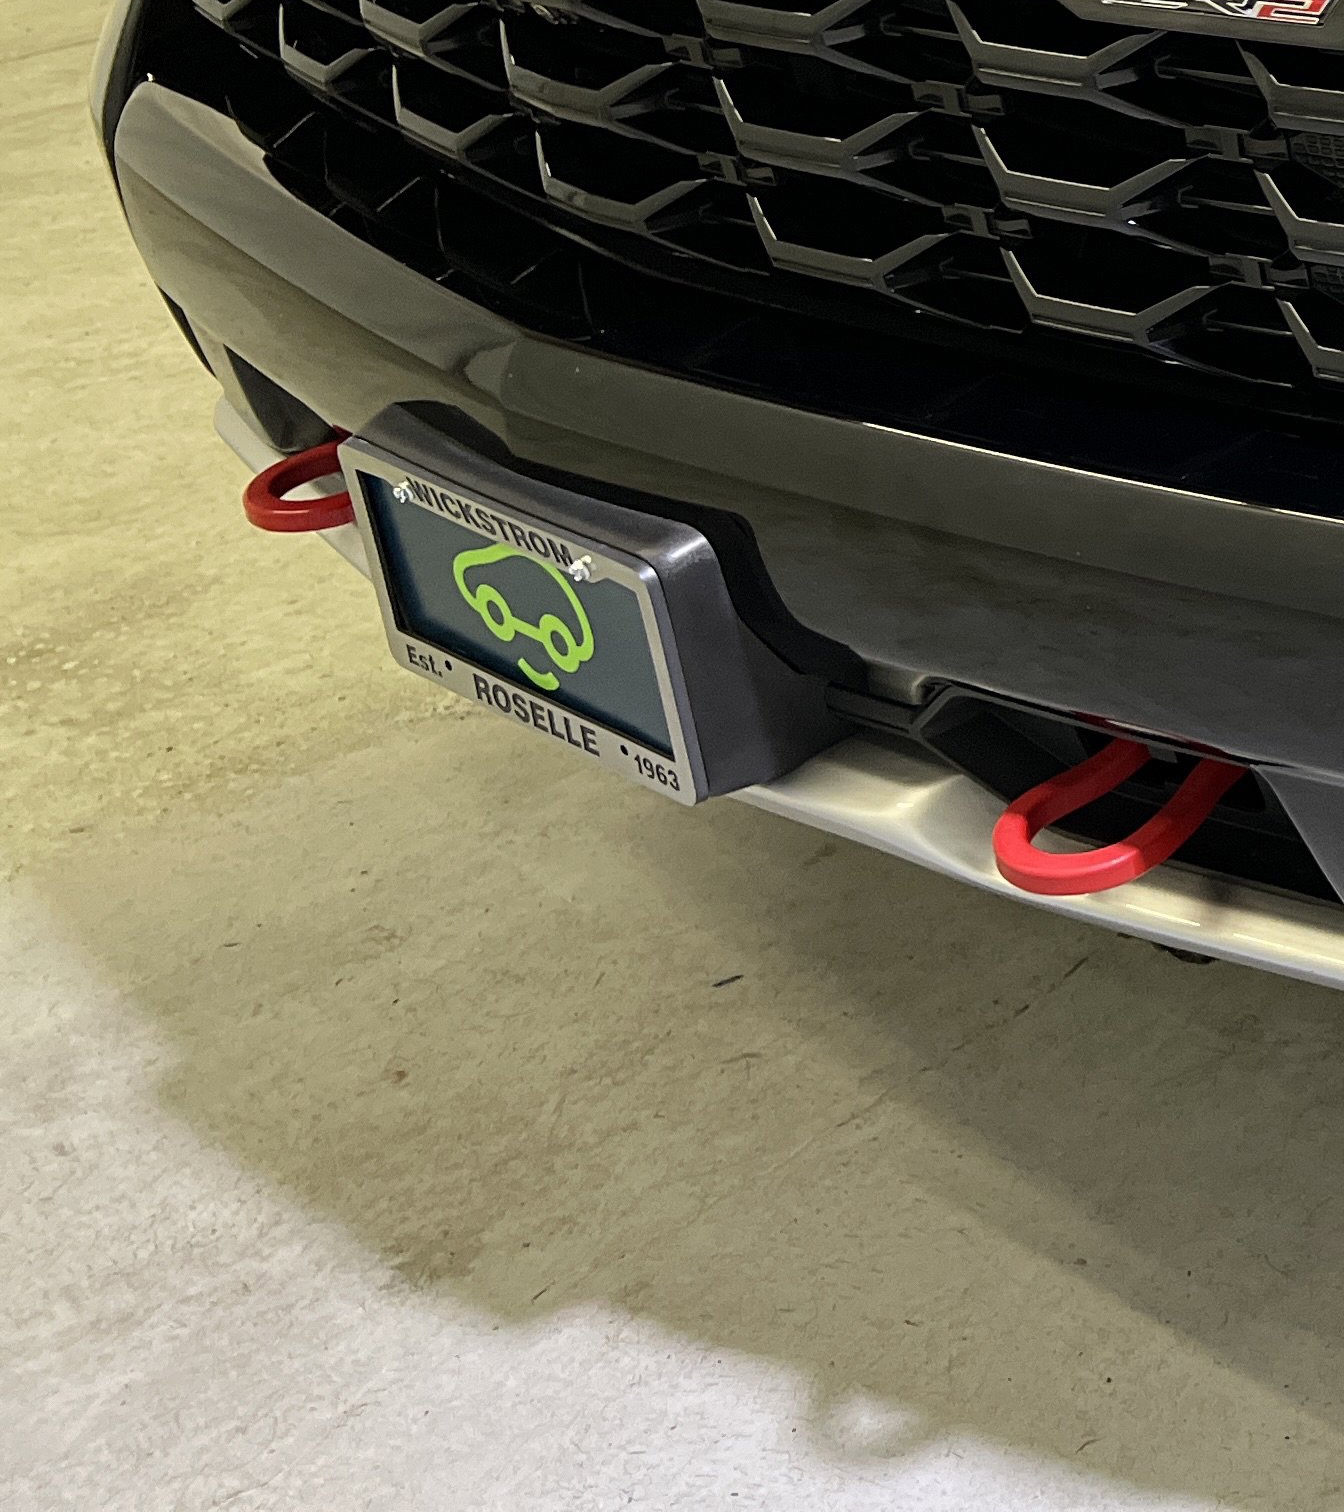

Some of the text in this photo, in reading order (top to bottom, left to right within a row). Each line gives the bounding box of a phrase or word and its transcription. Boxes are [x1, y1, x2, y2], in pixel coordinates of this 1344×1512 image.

[408, 476, 575, 568] WICKSTROM
[407, 644, 681, 791] Est. ROSELLE 1963
